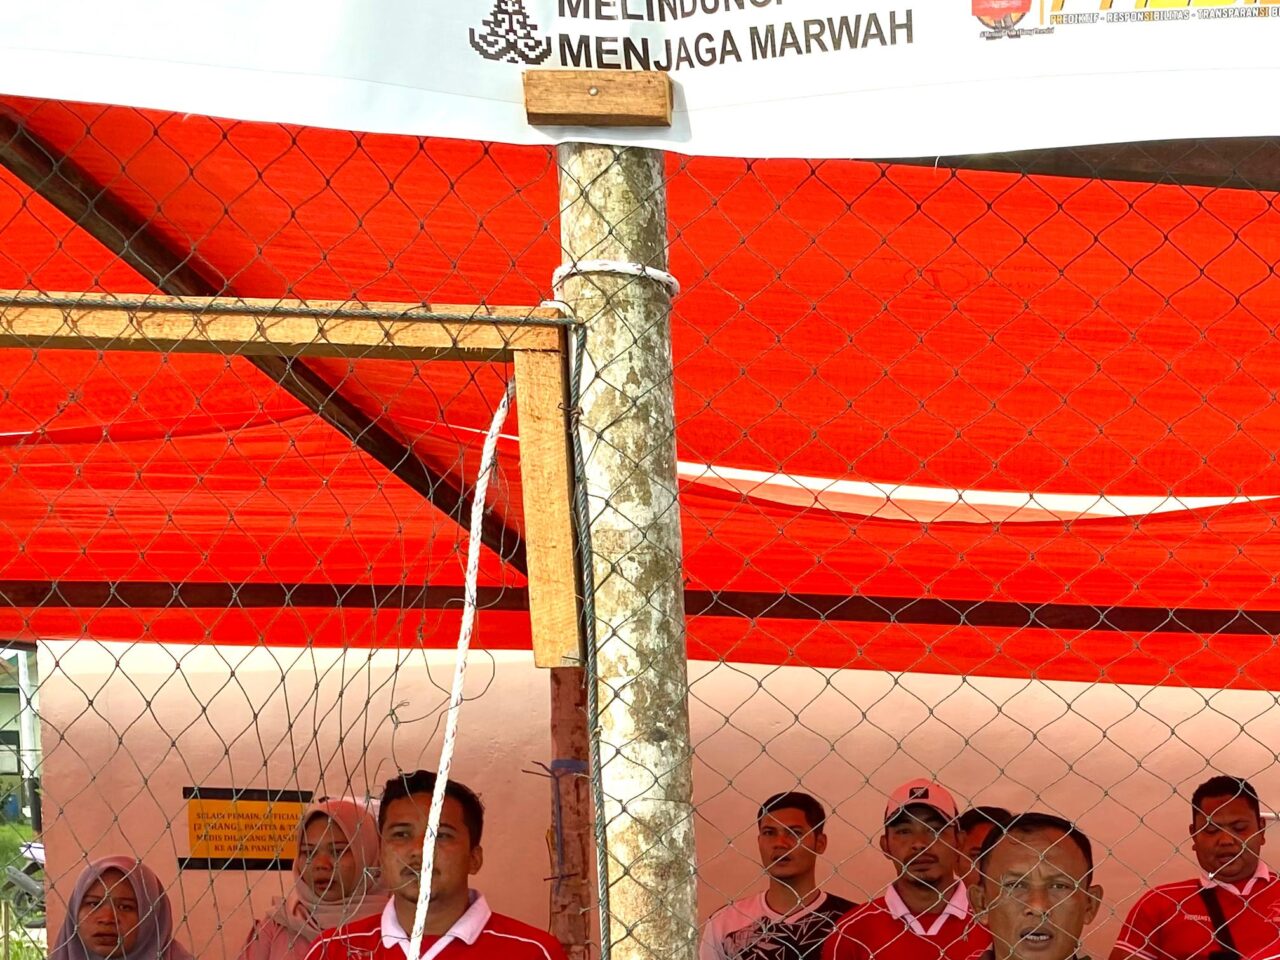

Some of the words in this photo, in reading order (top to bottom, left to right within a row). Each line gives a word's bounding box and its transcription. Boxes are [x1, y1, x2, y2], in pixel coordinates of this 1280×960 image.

[1050, 12, 1099, 25] PREDIKTIF
[1106, 9, 1190, 23] RESPONSIBILITAS
[1197, 7, 1270, 19] TRANSPARANSI
[558, 29, 742, 72] MENJAGA
[749, 9, 914, 61] MARWAH
